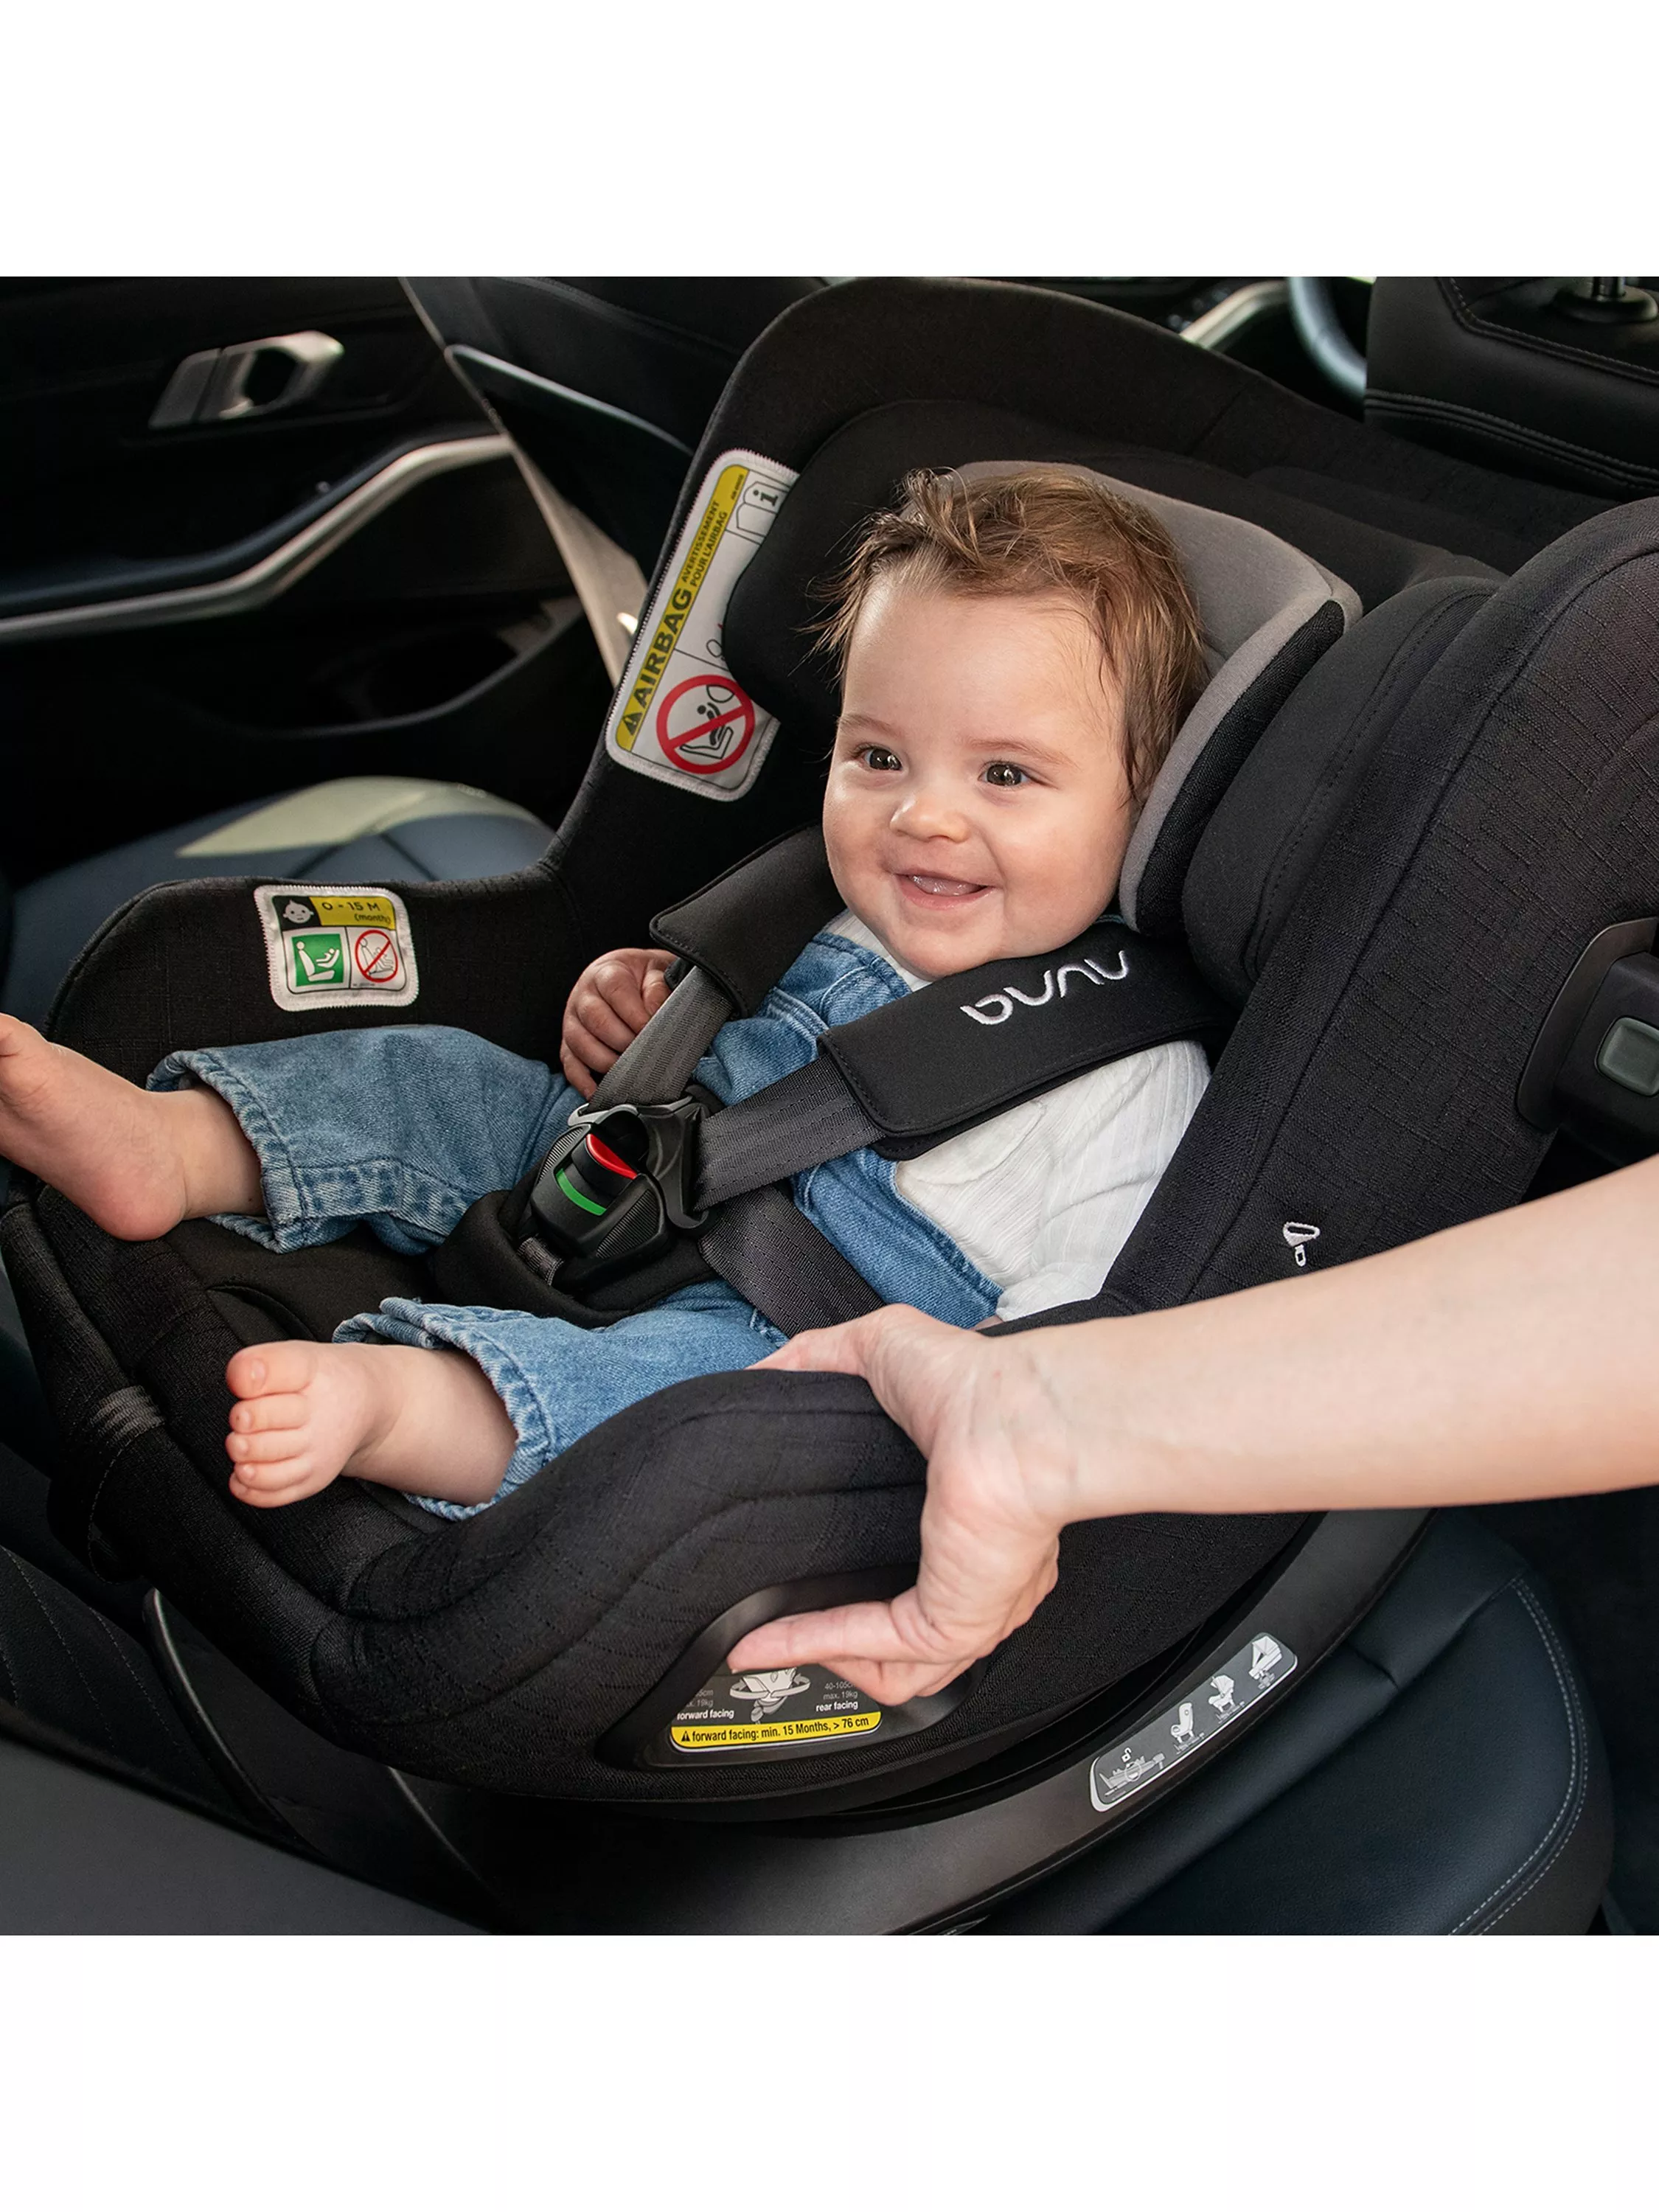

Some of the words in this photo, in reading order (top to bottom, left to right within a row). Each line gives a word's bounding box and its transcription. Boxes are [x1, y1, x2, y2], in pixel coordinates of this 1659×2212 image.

[681, 501, 720, 582] AVERTISSEMENT
[689, 557, 706, 587] POUR
[703, 511, 728, 557] L'AIRBAG
[633, 588, 692, 709] AIRBAG
[347, 902, 364, 911] 15
[366, 902, 380, 911] M
[709, 1708, 734, 1719] facing
[815, 1703, 832, 1712] rear
[834, 1700, 858, 1711] facing
[692, 1730, 727, 1742] forward
[728, 1728, 759, 1741] facing:
[761, 1727, 781, 1738] min.
[783, 1725, 794, 1735] 15
[796, 1721, 832, 1733] Months,
[841, 1717, 853, 1728] 76
[855, 1717, 869, 1727] cm
